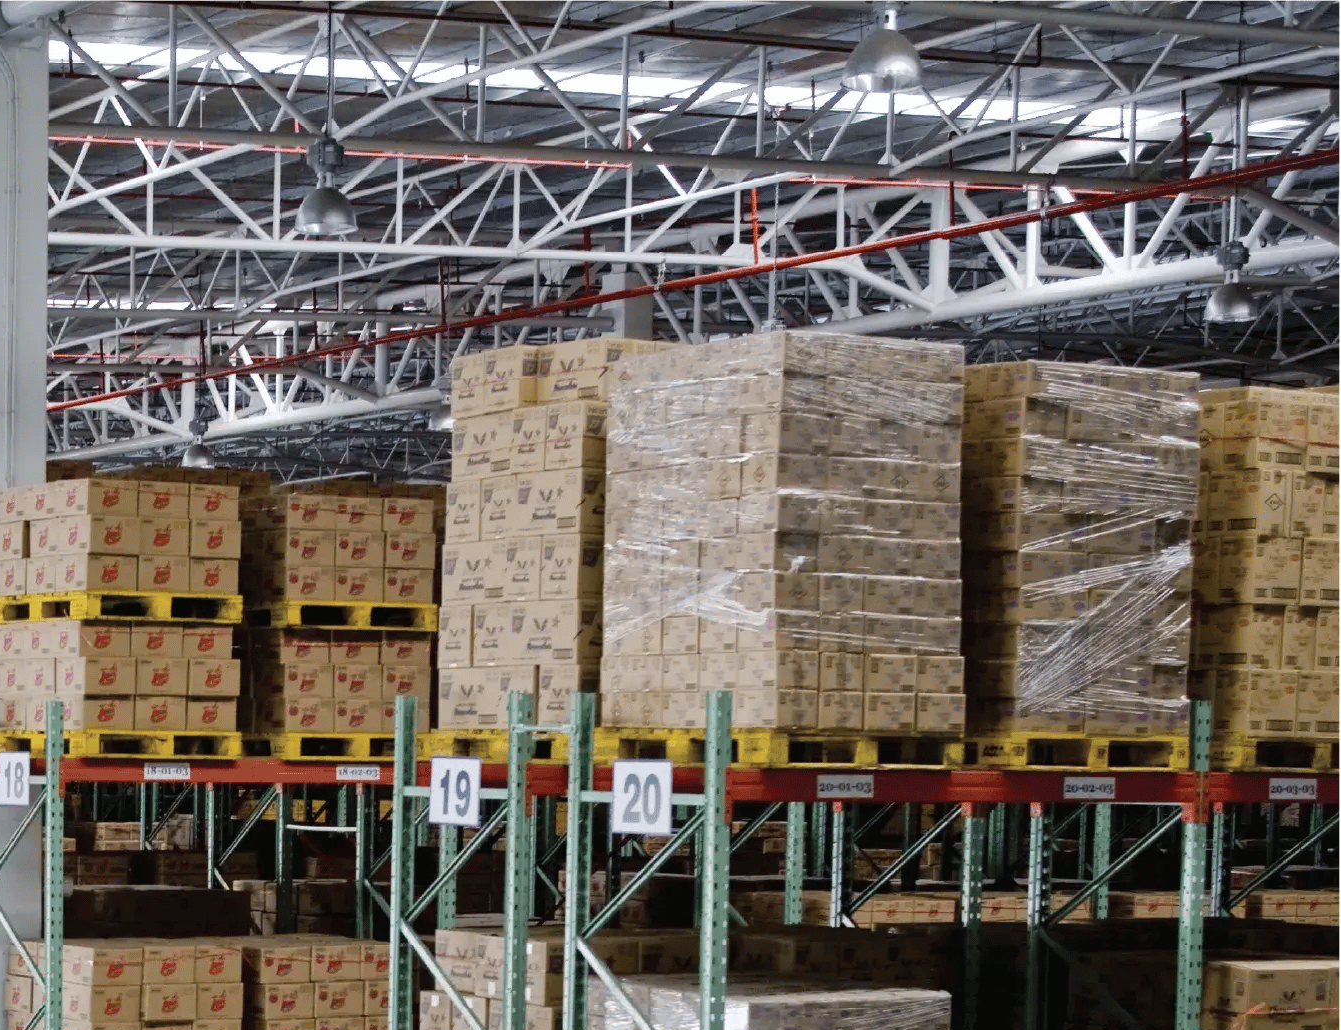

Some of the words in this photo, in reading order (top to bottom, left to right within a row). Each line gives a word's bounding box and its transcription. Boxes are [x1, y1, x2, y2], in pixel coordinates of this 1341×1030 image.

[146, 766, 189, 776] 18-01-03
[338, 768, 378, 778] 18-02-03
[4, 764, 25, 799] 18
[440, 768, 471, 818] 19
[819, 782, 872, 794] 20-01-03
[1064, 783, 1114, 794] 20-02-03
[1270, 784, 1315, 796] 20-03-03
[622, 772, 661, 825] 20
